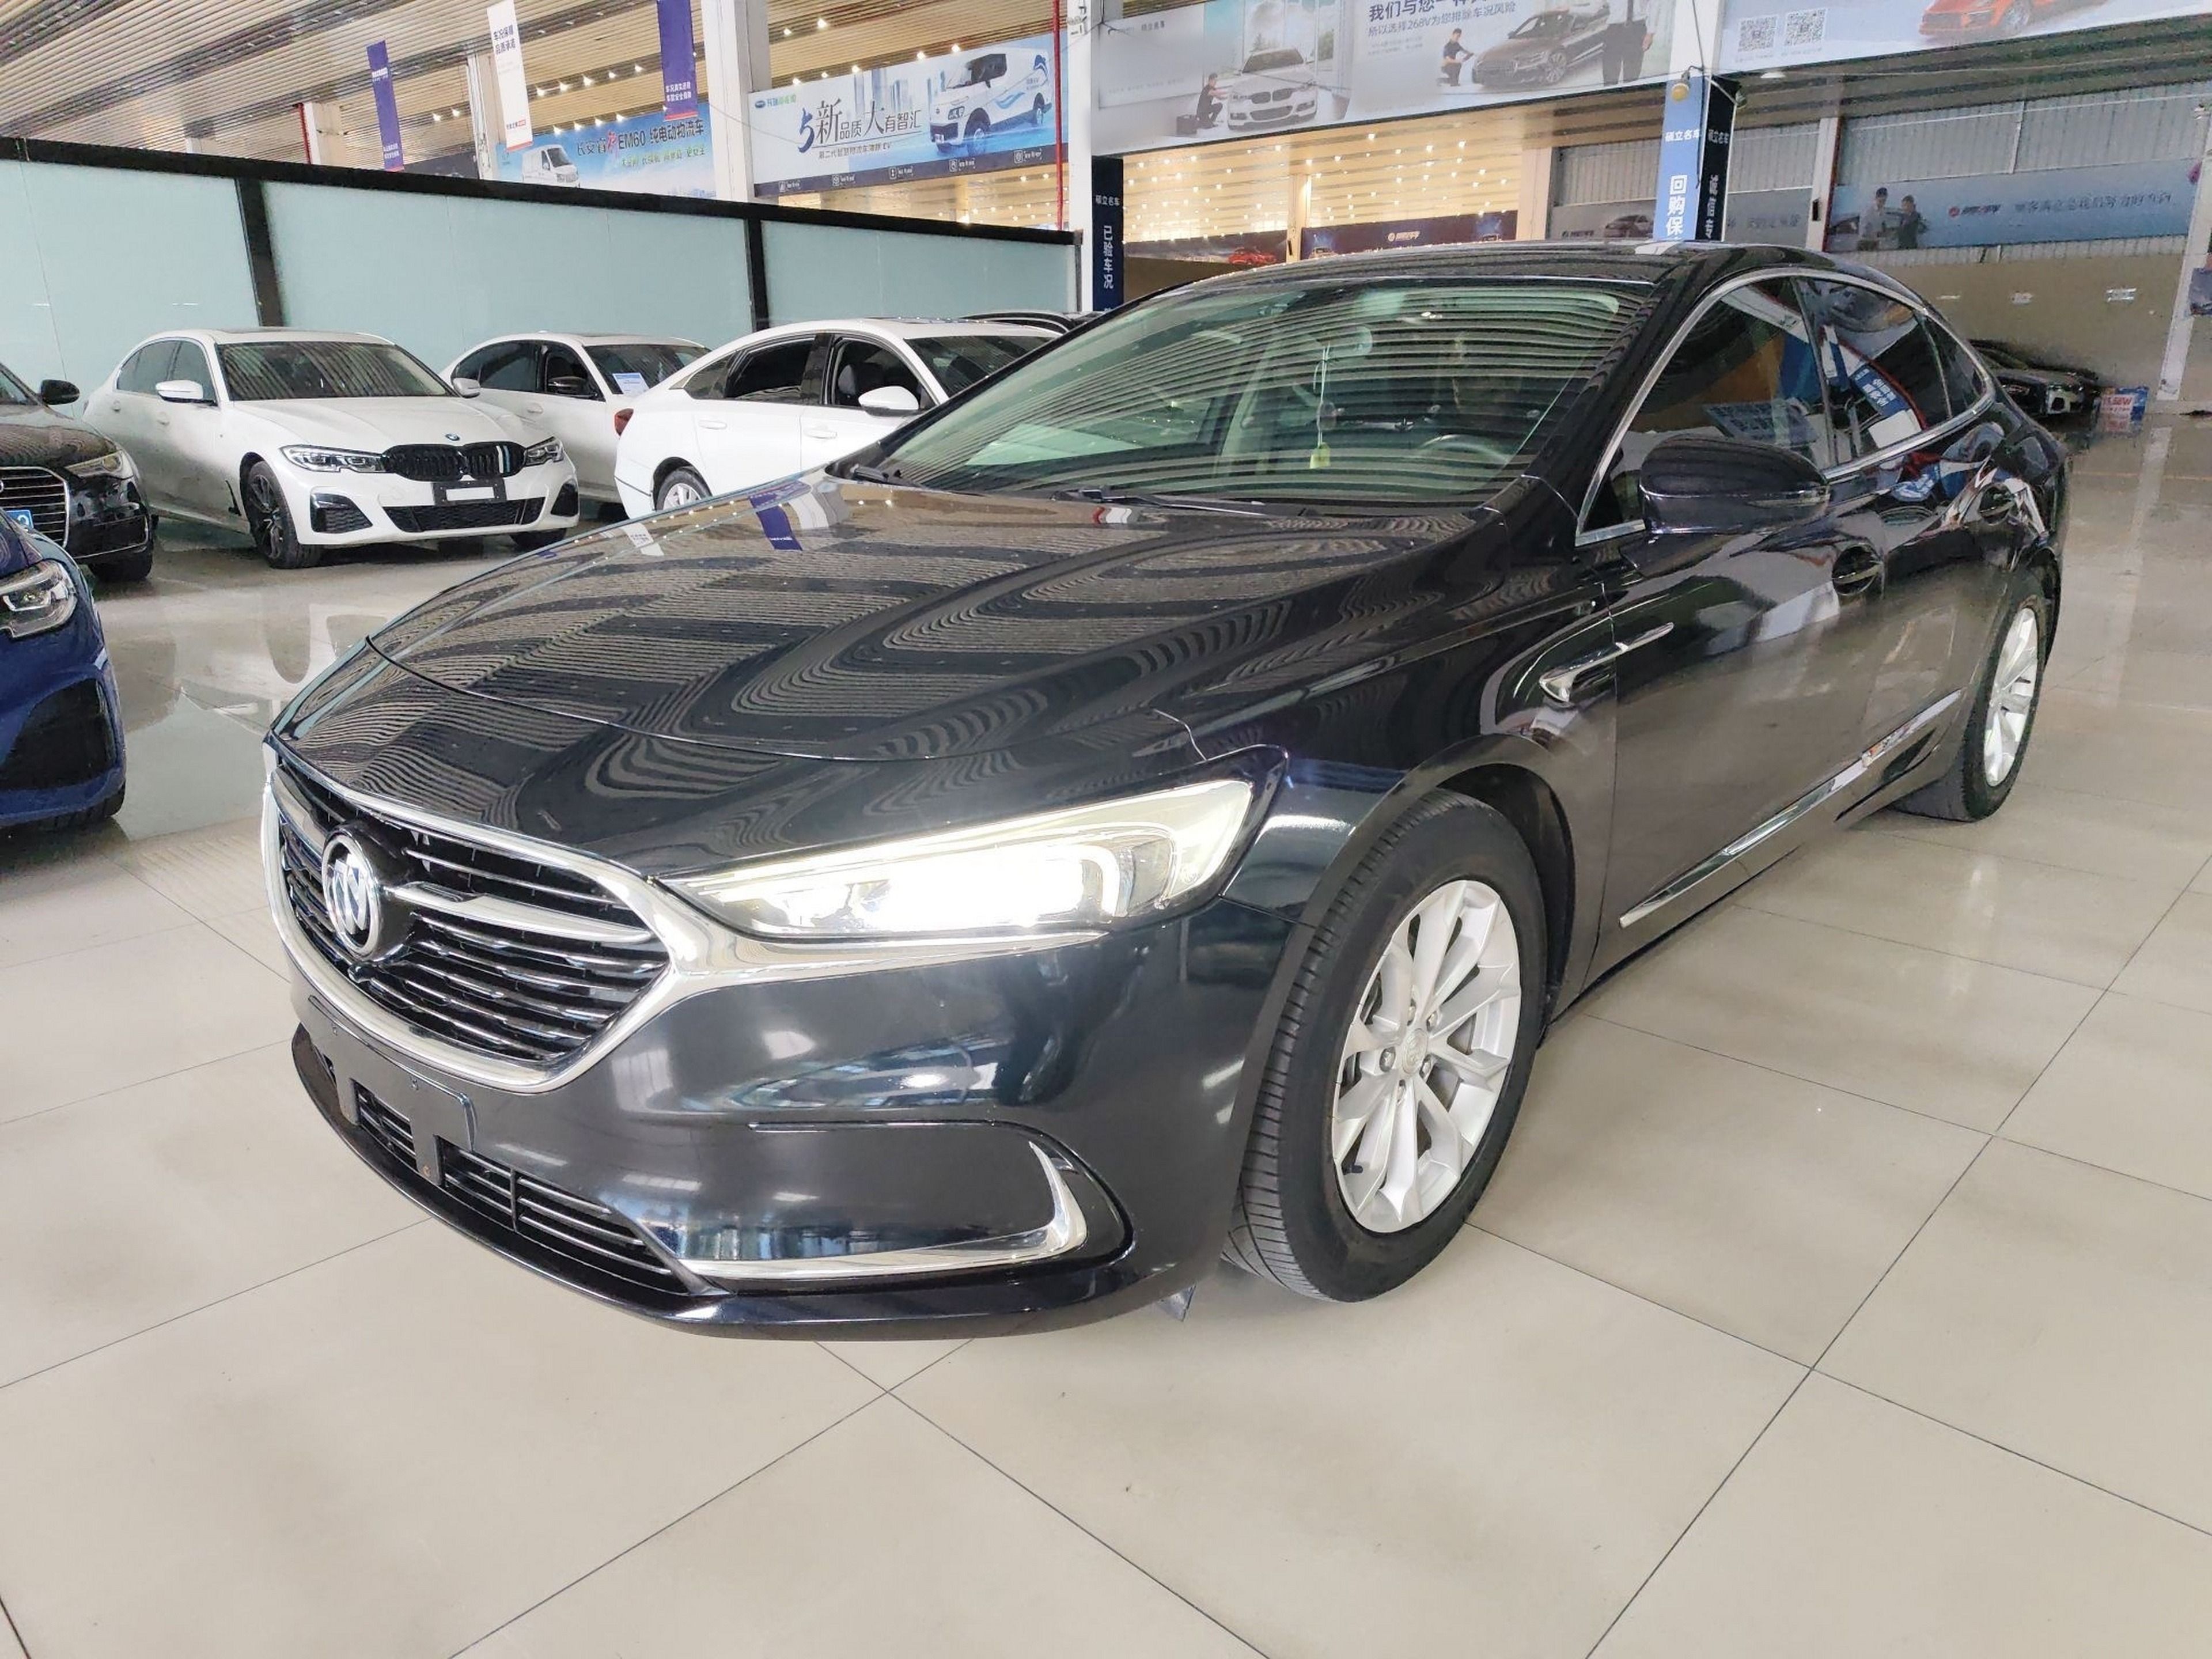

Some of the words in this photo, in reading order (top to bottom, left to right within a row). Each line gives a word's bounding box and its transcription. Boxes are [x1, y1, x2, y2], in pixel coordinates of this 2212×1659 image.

[1666, 175, 1687, 240] 回购保
[1103, 225, 1113, 289] 已验车况
